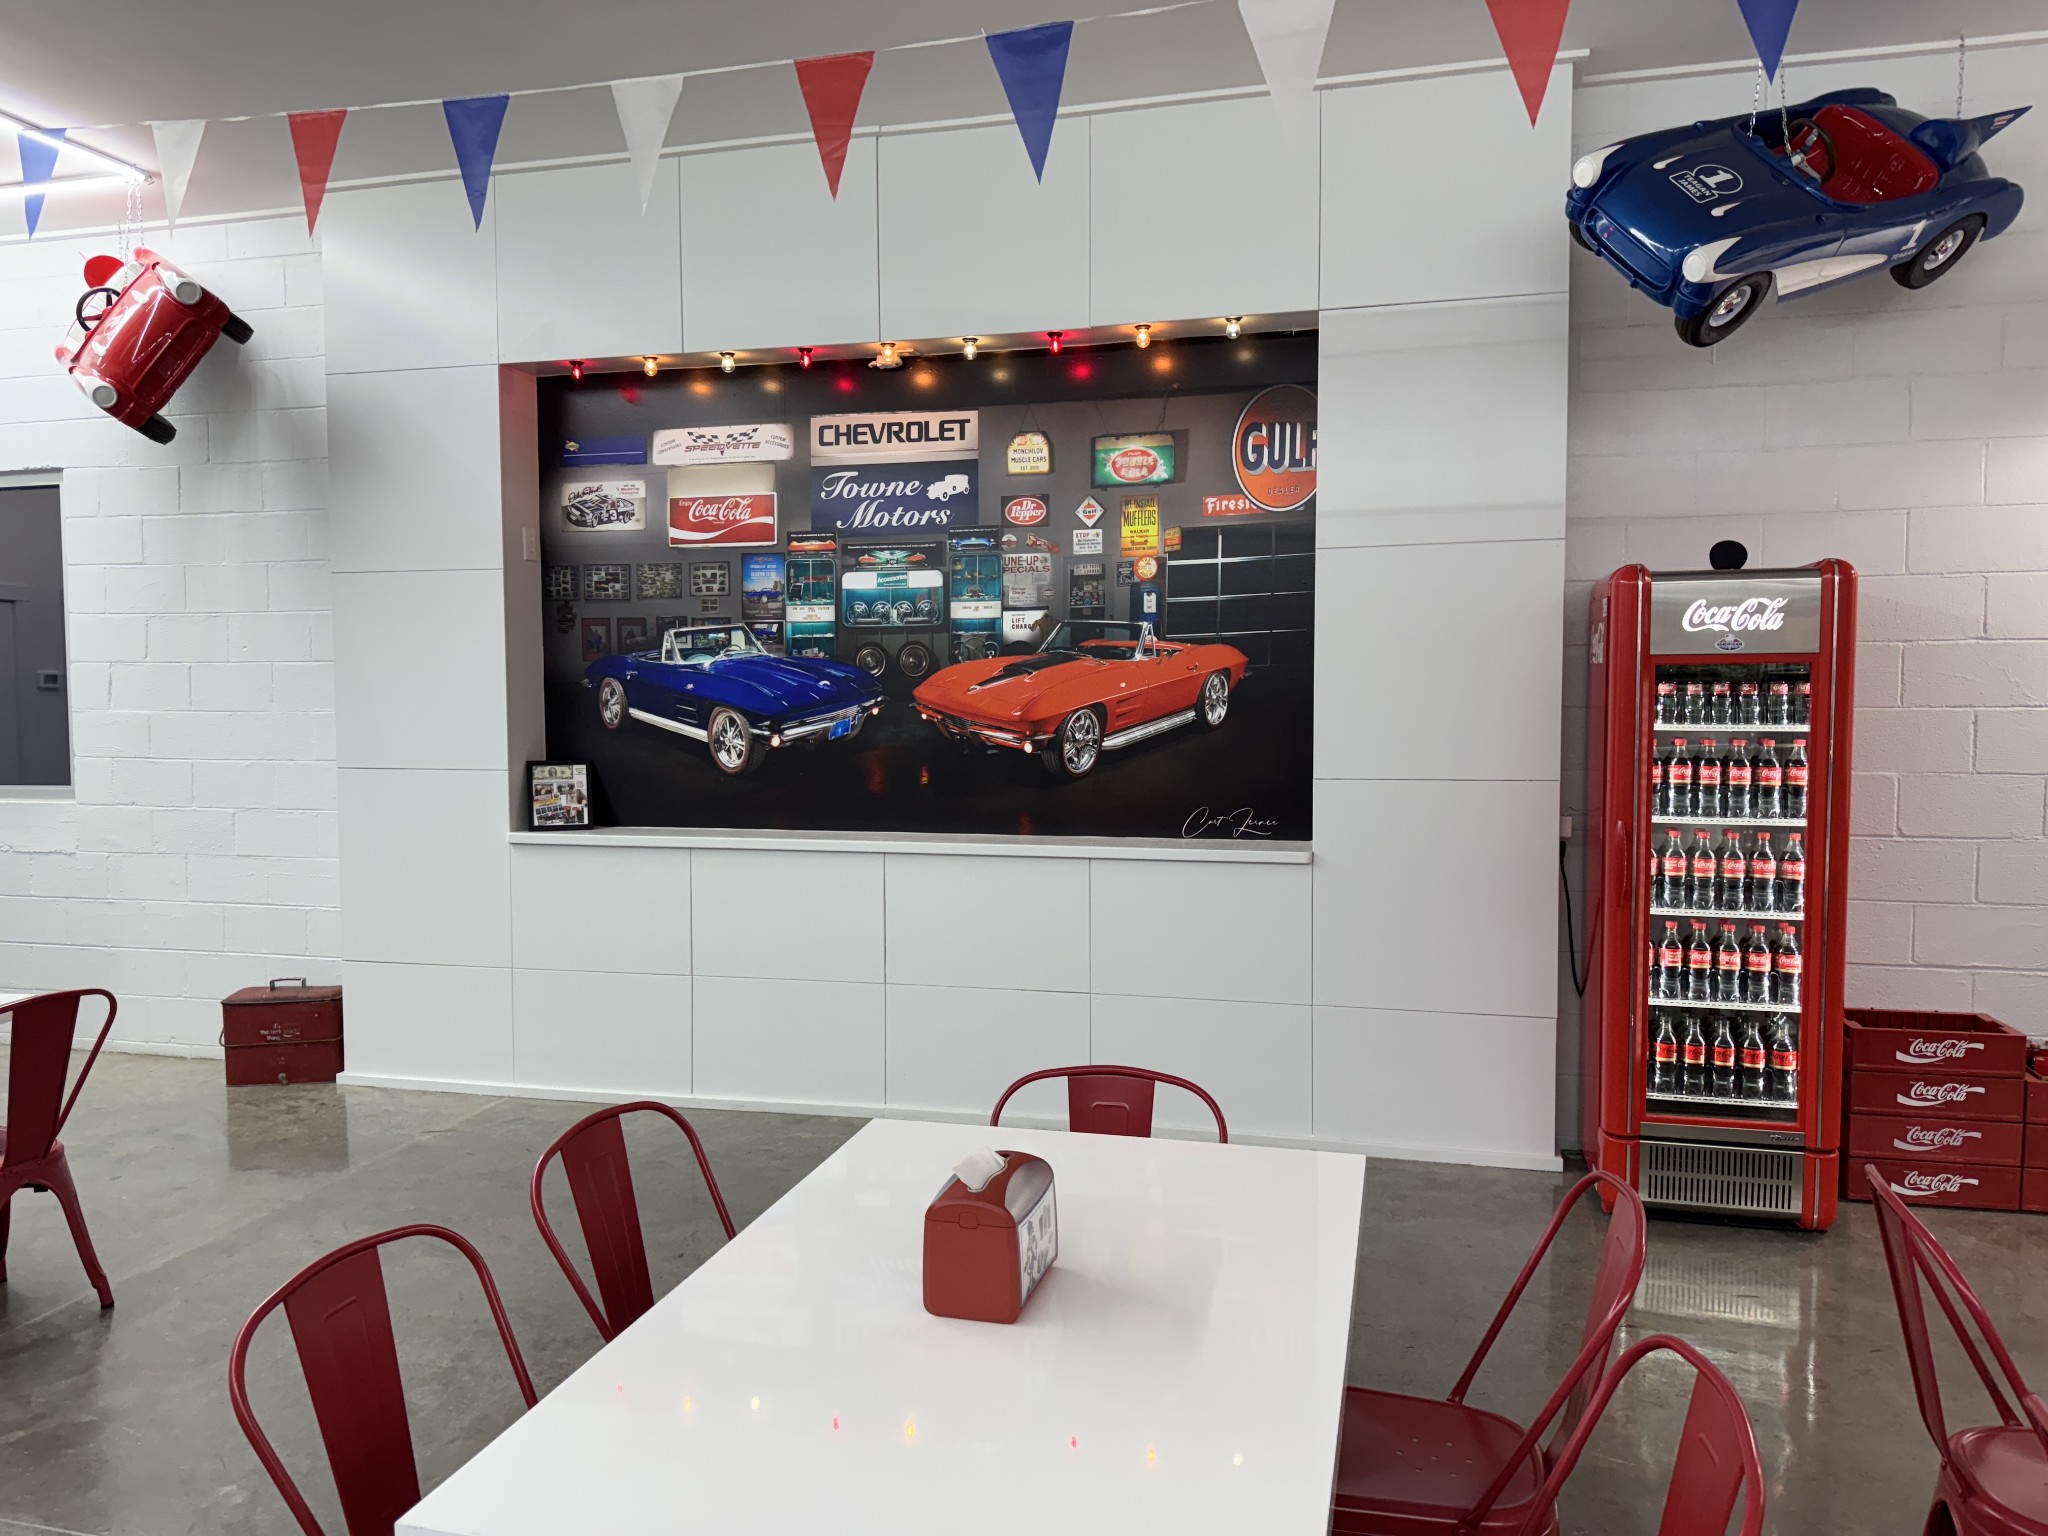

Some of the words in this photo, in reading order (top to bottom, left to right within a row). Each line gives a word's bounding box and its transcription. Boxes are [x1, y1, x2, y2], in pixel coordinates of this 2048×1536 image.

[1678, 179, 1702, 197] JAMES
[1683, 174, 1712, 196] TEAGAN
[1699, 169, 1734, 189] 1
[1900, 218, 1928, 251] 1
[818, 418, 971, 447] CHEVROLET
[684, 441, 762, 456] SPEEDVETTE
[1240, 421, 1317, 476] GULF
[1010, 456, 1032, 464] MUSCLE
[1121, 467, 1149, 478] COLA
[820, 470, 924, 500] Towne
[1267, 486, 1300, 496] DEALER
[679, 499, 693, 507] Enjoy
[689, 497, 753, 522] Coca-Cola
[1021, 499, 1036, 510] Dr
[1134, 497, 1156, 508] INSTALL
[610, 509, 618, 520] 3
[836, 499, 953, 529] Motors
[1011, 506, 1044, 521] Pepper
[1123, 509, 1157, 527] MUFFLERS
[1003, 555, 1040, 567] UNE-UP
[1003, 565, 1050, 574] PECIALS
[877, 574, 908, 584] Accessories
[1681, 597, 1789, 632] Coca-Cola
[1909, 1038, 1968, 1058] Coca-Cola
[1910, 1081, 1969, 1101] Coca-Cola
[1906, 1125, 1966, 1146] Coca-Cola
[1904, 1170, 1963, 1192] Coca-Cola
